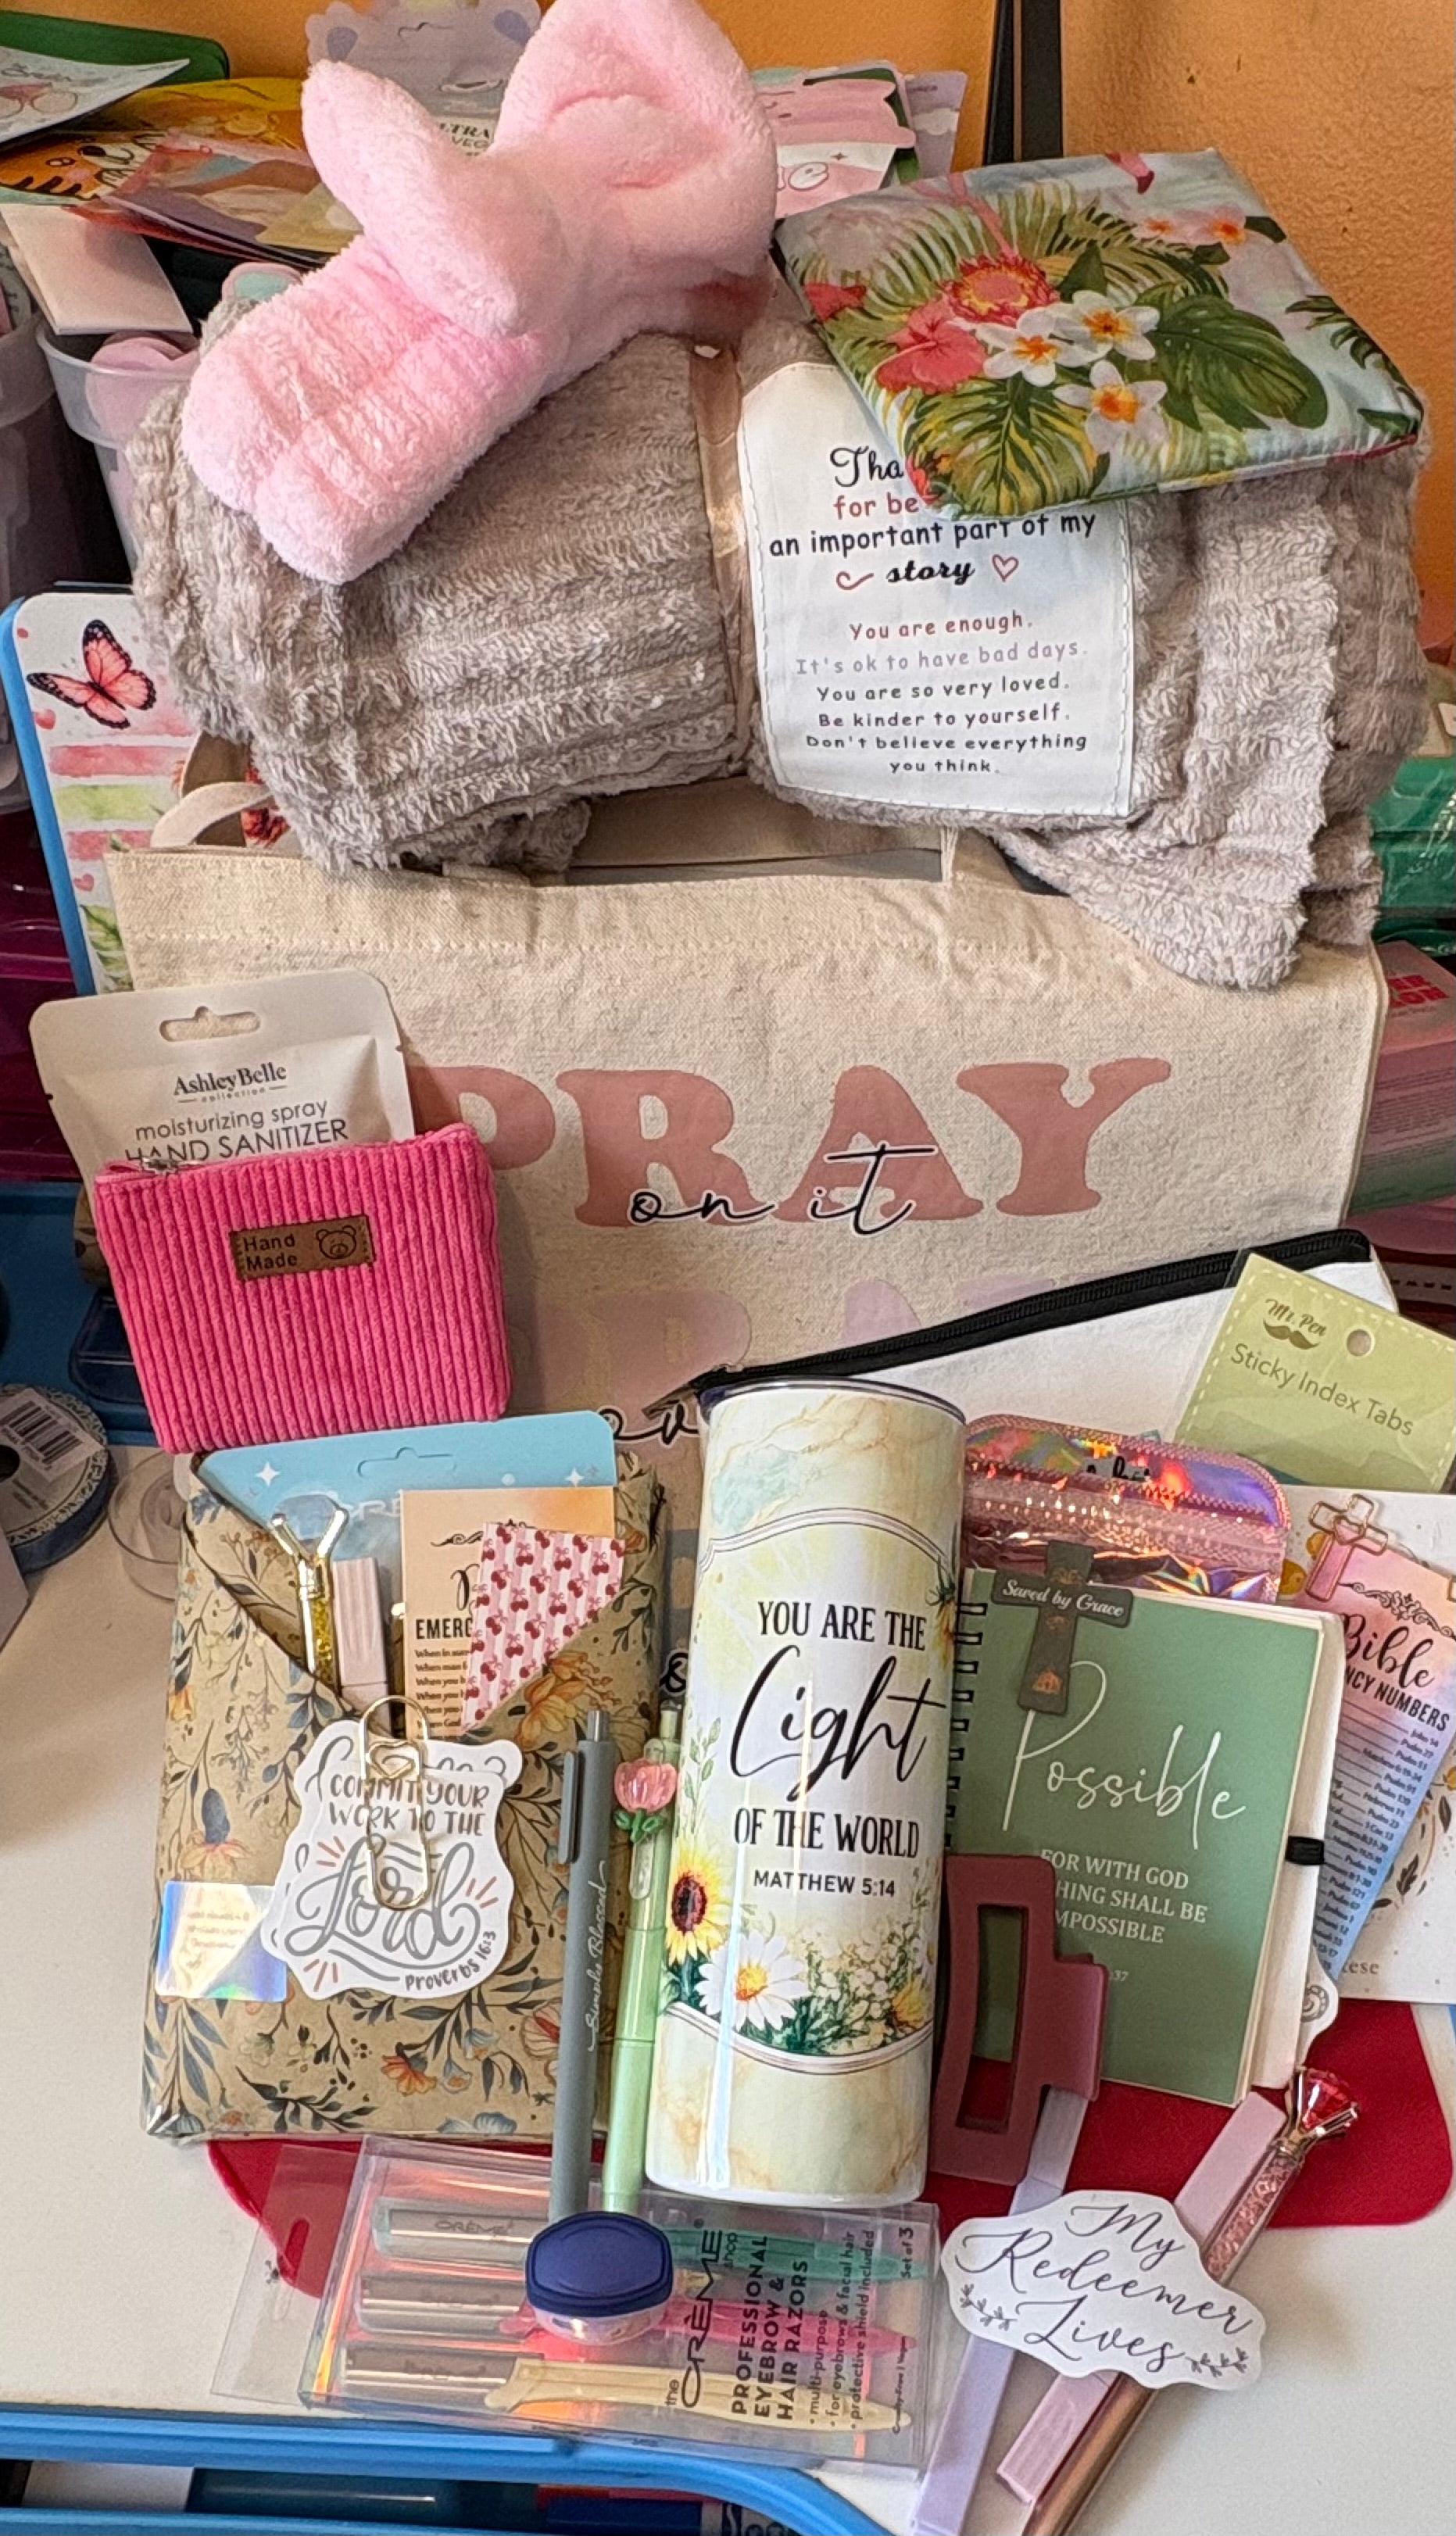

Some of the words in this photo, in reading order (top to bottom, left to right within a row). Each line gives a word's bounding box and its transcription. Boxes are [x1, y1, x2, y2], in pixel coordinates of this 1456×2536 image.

[833, 494, 876, 520] for
[770, 537, 800, 556] an
[810, 524, 943, 558] important
[954, 520, 1011, 548] part
[1061, 513, 1096, 538] my
[886, 559, 975, 585] story
[850, 623, 889, 641] You
[899, 622, 935, 638] are
[946, 610, 1033, 632] enough.
[796, 657, 843, 676] It's
[853, 655, 878, 674] ok
[886, 654, 908, 671] to
[918, 649, 970, 669] have
[979, 642, 1018, 663] bad
[1029, 641, 1089, 664] days.
[817, 685, 856, 703] You
[865, 685, 901, 699] are
[911, 685, 934, 698] so
[943, 680, 992, 699] very
[1002, 672, 1071, 693] loved.
[819, 713, 843, 727] Be
[853, 712, 925, 727] kinder
[934, 712, 956, 726] to
[966, 703, 1071, 728] yourself.
[807, 735, 867, 749] Don't
[876, 735, 956, 749] believe
[965, 733, 1087, 753] everything
[889, 760, 925, 774] you
[935, 758, 1000, 773] think.
[135, 1111, 264, 1141] moisturizing
[271, 1100, 327, 1124] spray
[219, 1119, 349, 1159] SANITIZER
[629, 1187, 775, 1226] on
[808, 1141, 937, 1235] it
[243, 1233, 295, 1251] Hand
[246, 1253, 298, 1271] Made
[1299, 1311, 1328, 1337] Pen
[1231, 1343, 1296, 1390] Sticky
[1299, 1372, 1359, 1415] Index
[1363, 1399, 1415, 1437] Tabs
[1051, 1589, 1074, 1611] by
[1076, 1594, 1125, 1619] Grace
[757, 1601, 813, 1636] YOU
[820, 1603, 875, 1643] ARE
[885, 1609, 928, 1651] THE
[1340, 1613, 1435, 1689] Bible
[729, 1644, 947, 1802] Light
[1375, 1683, 1451, 1733] NUMBERS
[1003, 1661, 1247, 1850] Possible
[424, 1780, 490, 1808] YOUR
[444, 1811, 485, 1837] THE
[734, 1807, 767, 1845] OF
[774, 1808, 826, 1850] THE
[834, 1815, 920, 1859] WORLD
[753, 1869, 857, 1895] MATTHEW
[861, 1877, 896, 1898] 5:14
[1041, 1849, 1080, 1872] FOR
[1086, 1855, 1142, 1882] WITH
[1145, 1866, 1189, 1890] GOD
[284, 1831, 481, 1968] Lord
[587, 1869, 606, 1960] Blessed
[1110, 1890, 1175, 1916] SHALL
[1179, 1901, 1208, 1923] BE
[475, 1930, 497, 1962] 16:3
[724, 2232, 739, 2268] shop
[840, 2231, 854, 2259] hair
[900, 2227, 914, 2240] 3
[1064, 2204, 1186, 2271] My
[840, 2261, 852, 2299] facial
[861, 2230, 875, 2291] included
[900, 2259, 912, 2279] Set
[954, 2227, 1253, 2335] Redeemer
[731, 2237, 767, 2414] PROFESSIONAL
[785, 2261, 808, 2355] RAZORS
[859, 2291, 870, 2337] shield
[754, 2300, 782, 2418] EYEBROW
[769, 2277, 785, 2291] &
[833, 2317, 849, 2389] eyebrows
[1015, 2295, 1187, 2373] Lives
[665, 2379, 680, 2406] the
[776, 2363, 798, 2420] HAIR
[850, 2339, 864, 2420] protective
[826, 2391, 839, 2420] for
